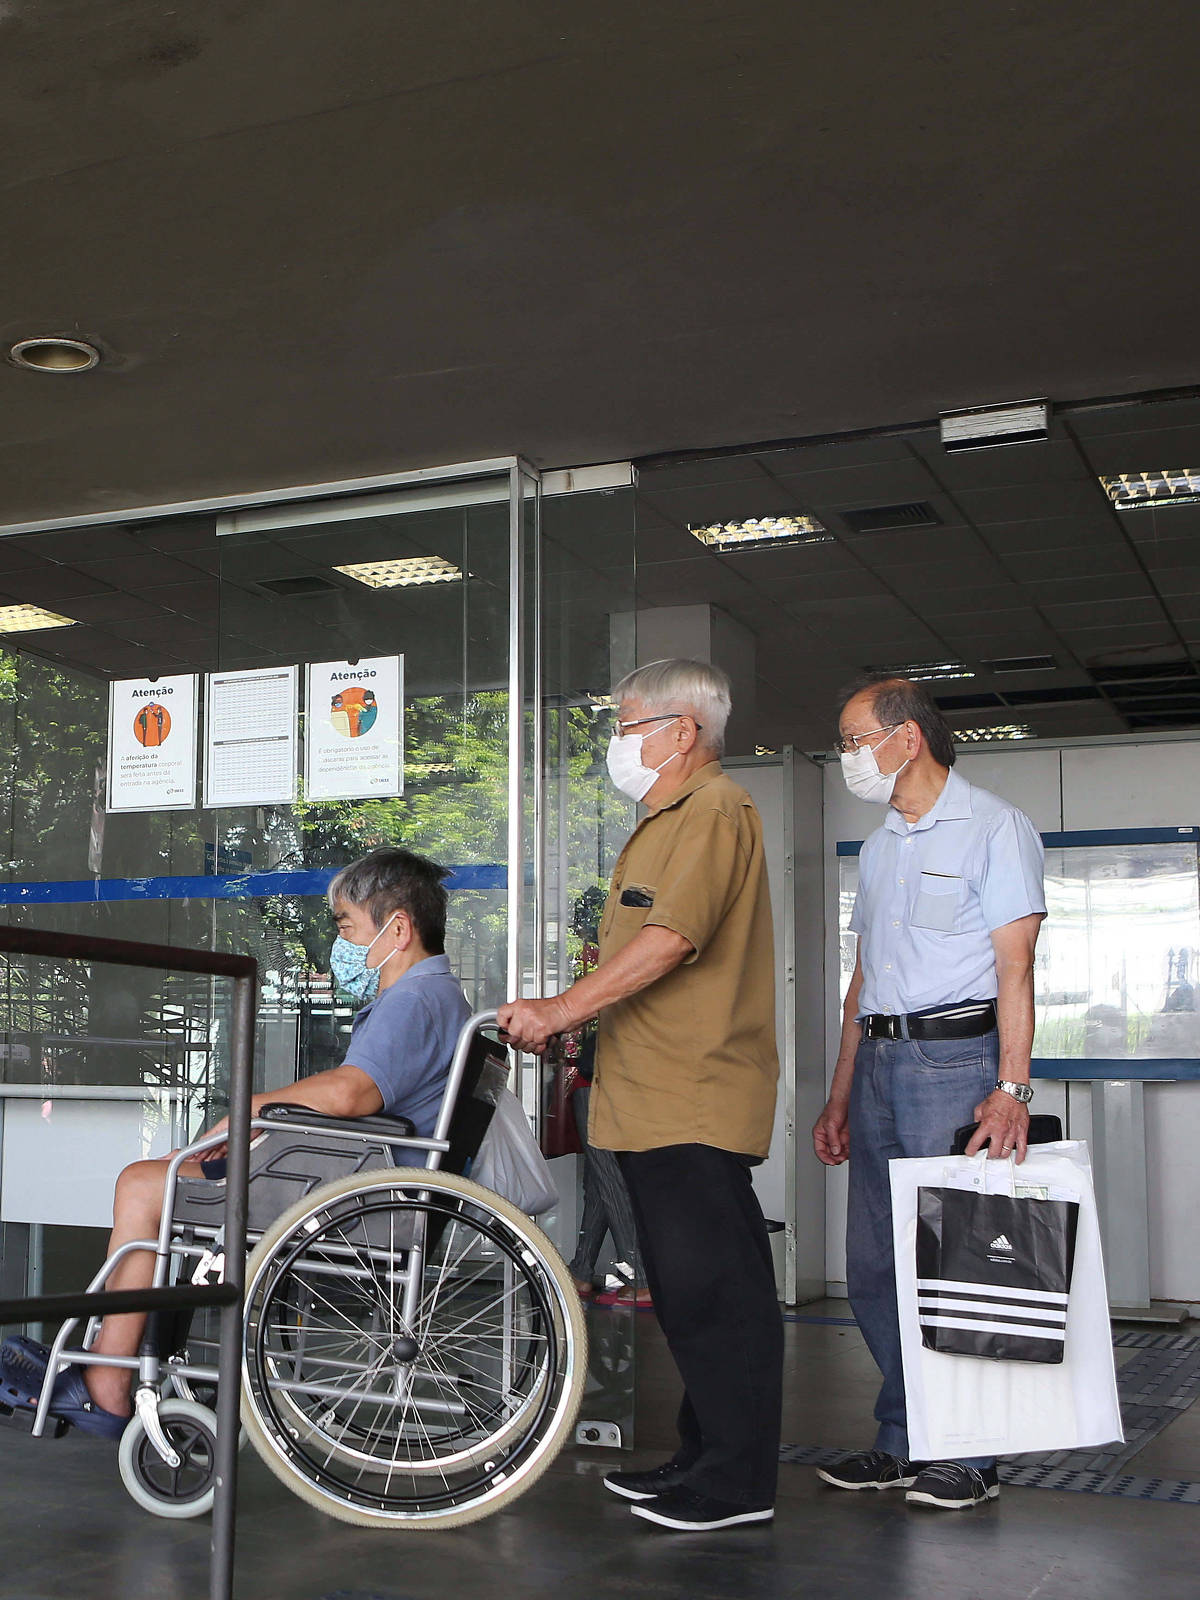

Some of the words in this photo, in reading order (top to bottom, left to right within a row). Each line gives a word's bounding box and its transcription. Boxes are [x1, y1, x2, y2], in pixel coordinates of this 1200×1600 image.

[330, 669, 377, 681] Atenção
[132, 686, 174, 698] Atenção
[990, 1242, 1012, 1250] adidas
